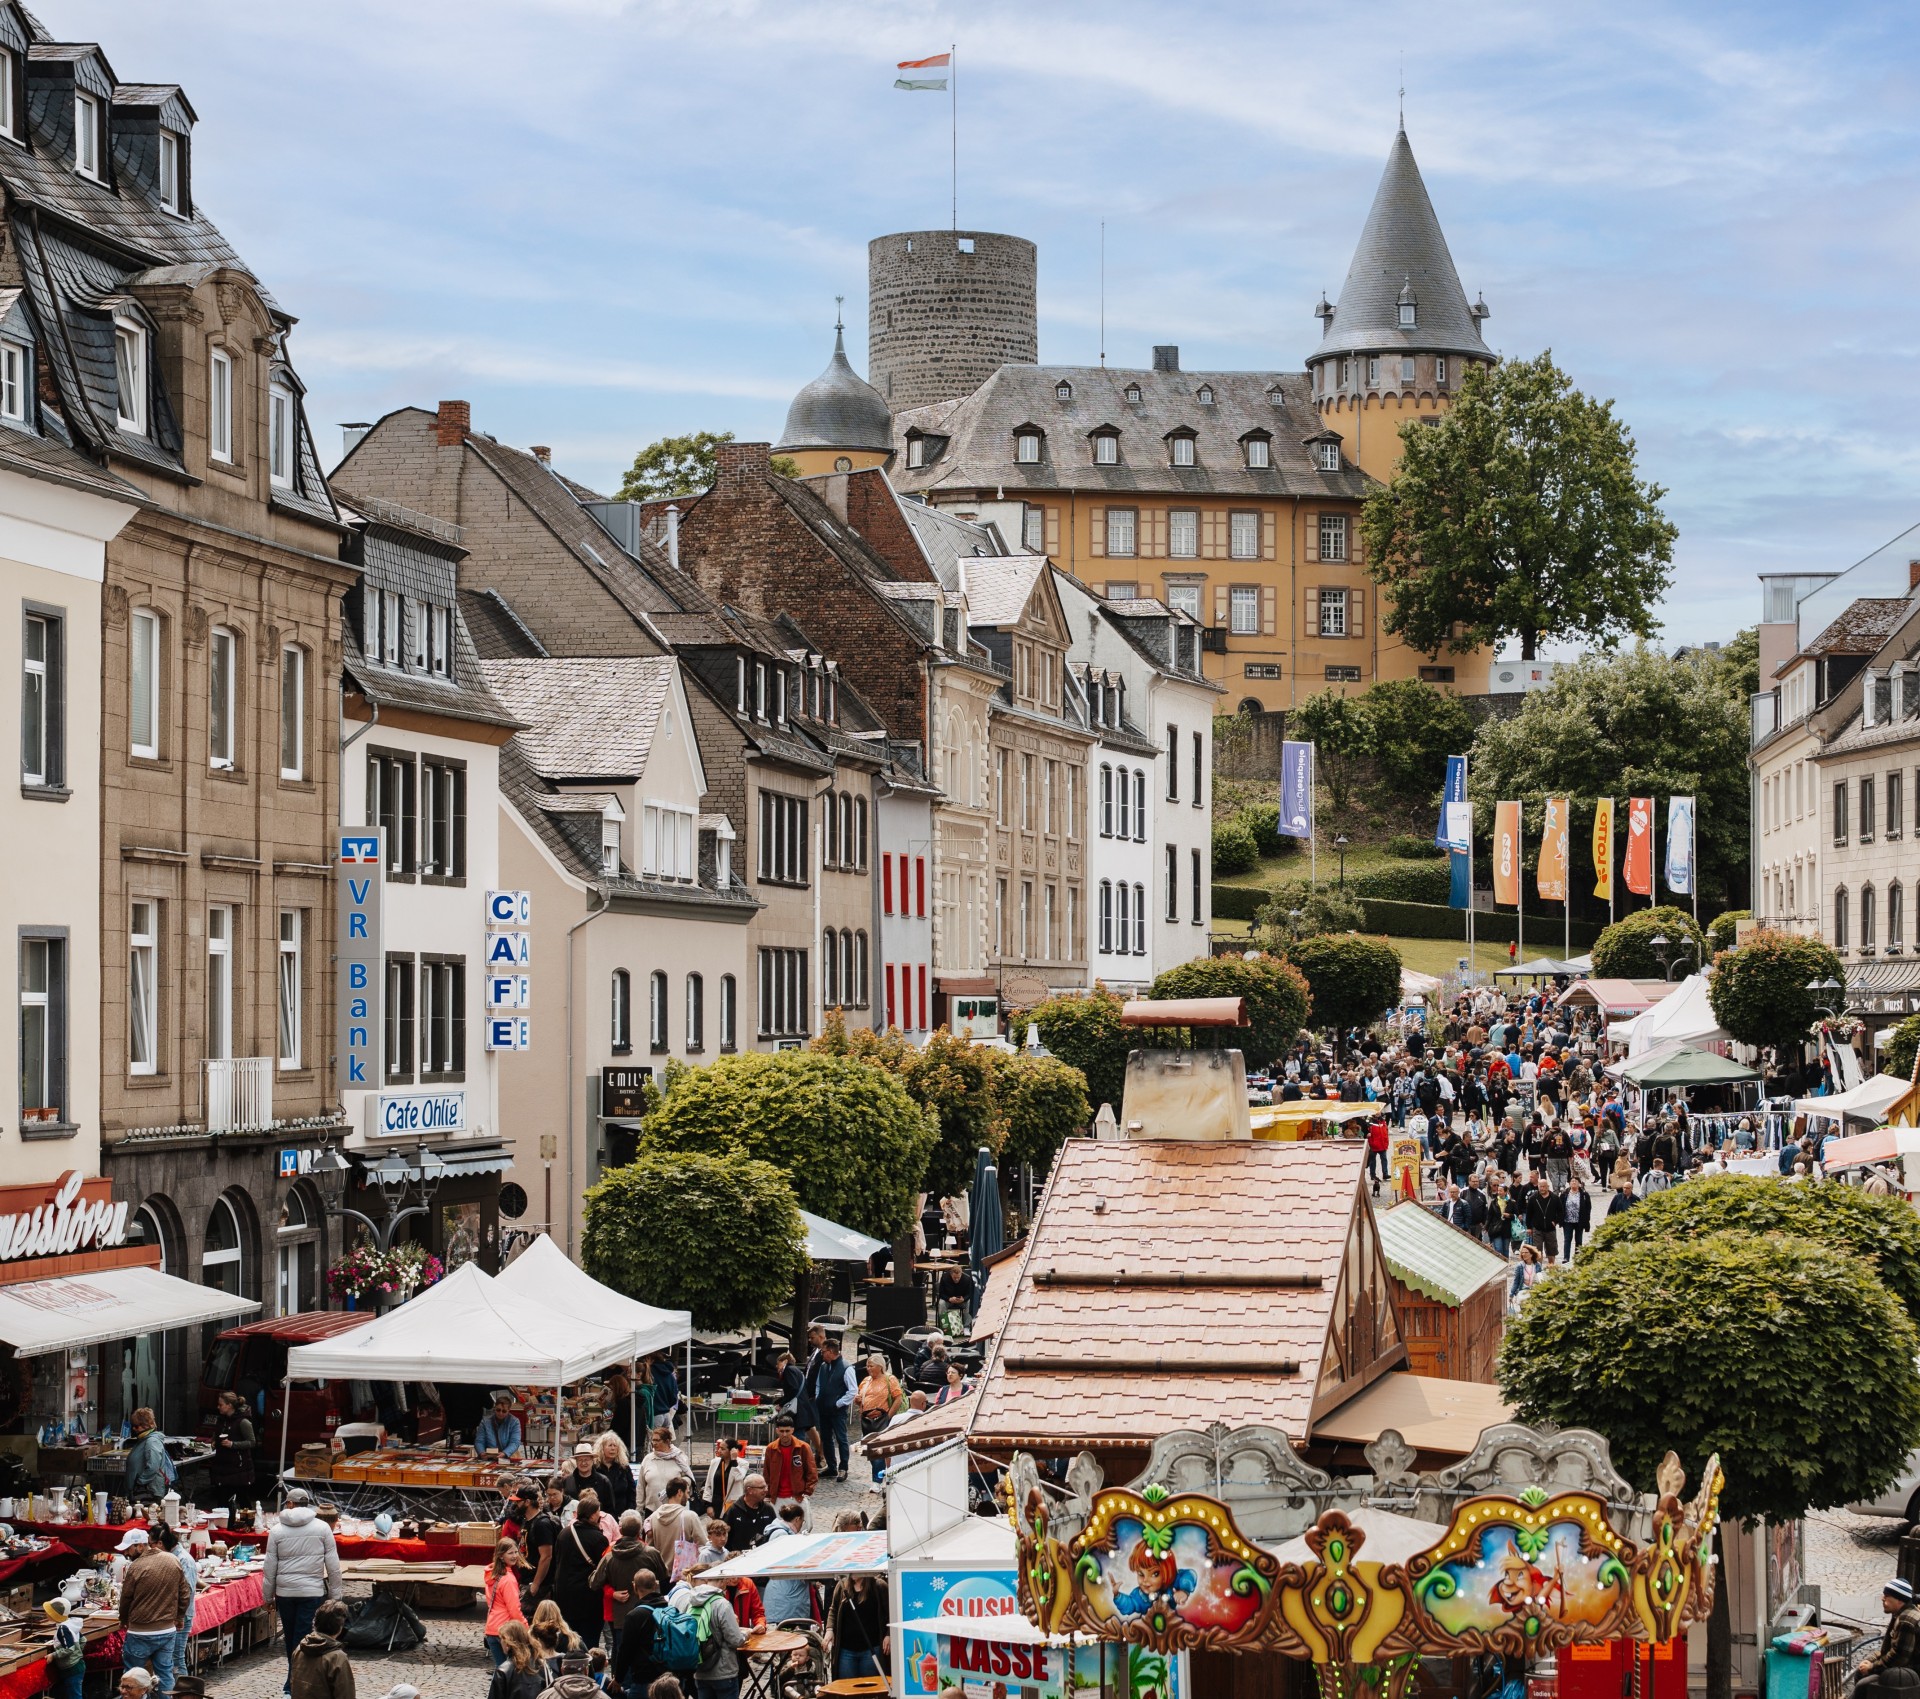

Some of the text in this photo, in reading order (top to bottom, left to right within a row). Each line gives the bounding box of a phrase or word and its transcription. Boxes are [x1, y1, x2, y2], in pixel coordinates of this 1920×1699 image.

[348, 878, 371, 1083] VR Bank
[491, 895, 515, 1046] CAFE
[520, 896, 529, 1046] CAFE
[386, 1098, 458, 1130] Cafe Ohlig
[942, 1597, 1014, 1617] SLUSH
[950, 1635, 1049, 1681] KASSE
